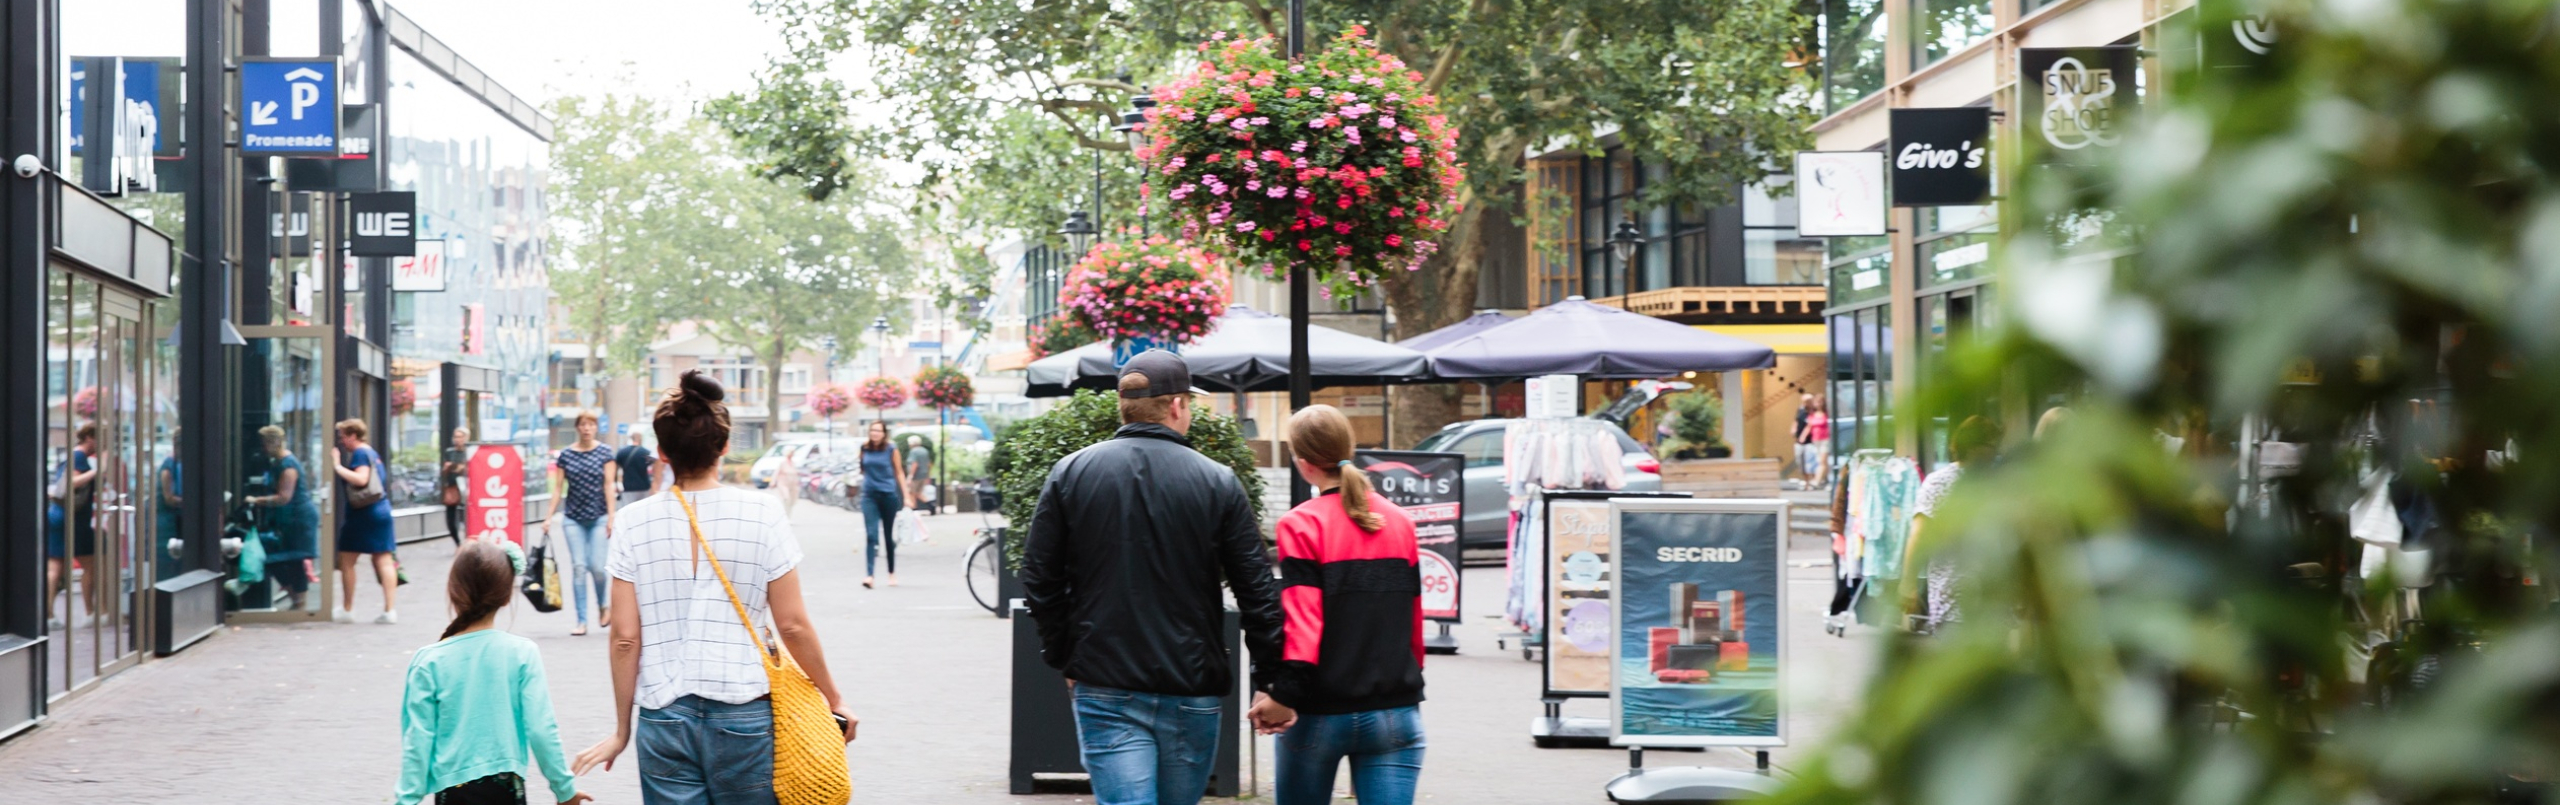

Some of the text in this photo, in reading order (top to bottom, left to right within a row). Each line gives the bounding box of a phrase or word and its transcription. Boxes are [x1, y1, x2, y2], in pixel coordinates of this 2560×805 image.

[2047, 73, 2109, 96] SNUF
[291, 82, 320, 120] P
[2047, 109, 2110, 132] SHOE
[246, 133, 333, 147] Promenade
[1896, 140, 1985, 170] Givo's
[357, 212, 410, 236] WE
[1382, 476, 1450, 494] ORIS
[1411, 506, 1455, 520] SACTIE
[1656, 546, 1743, 563] SECRID
